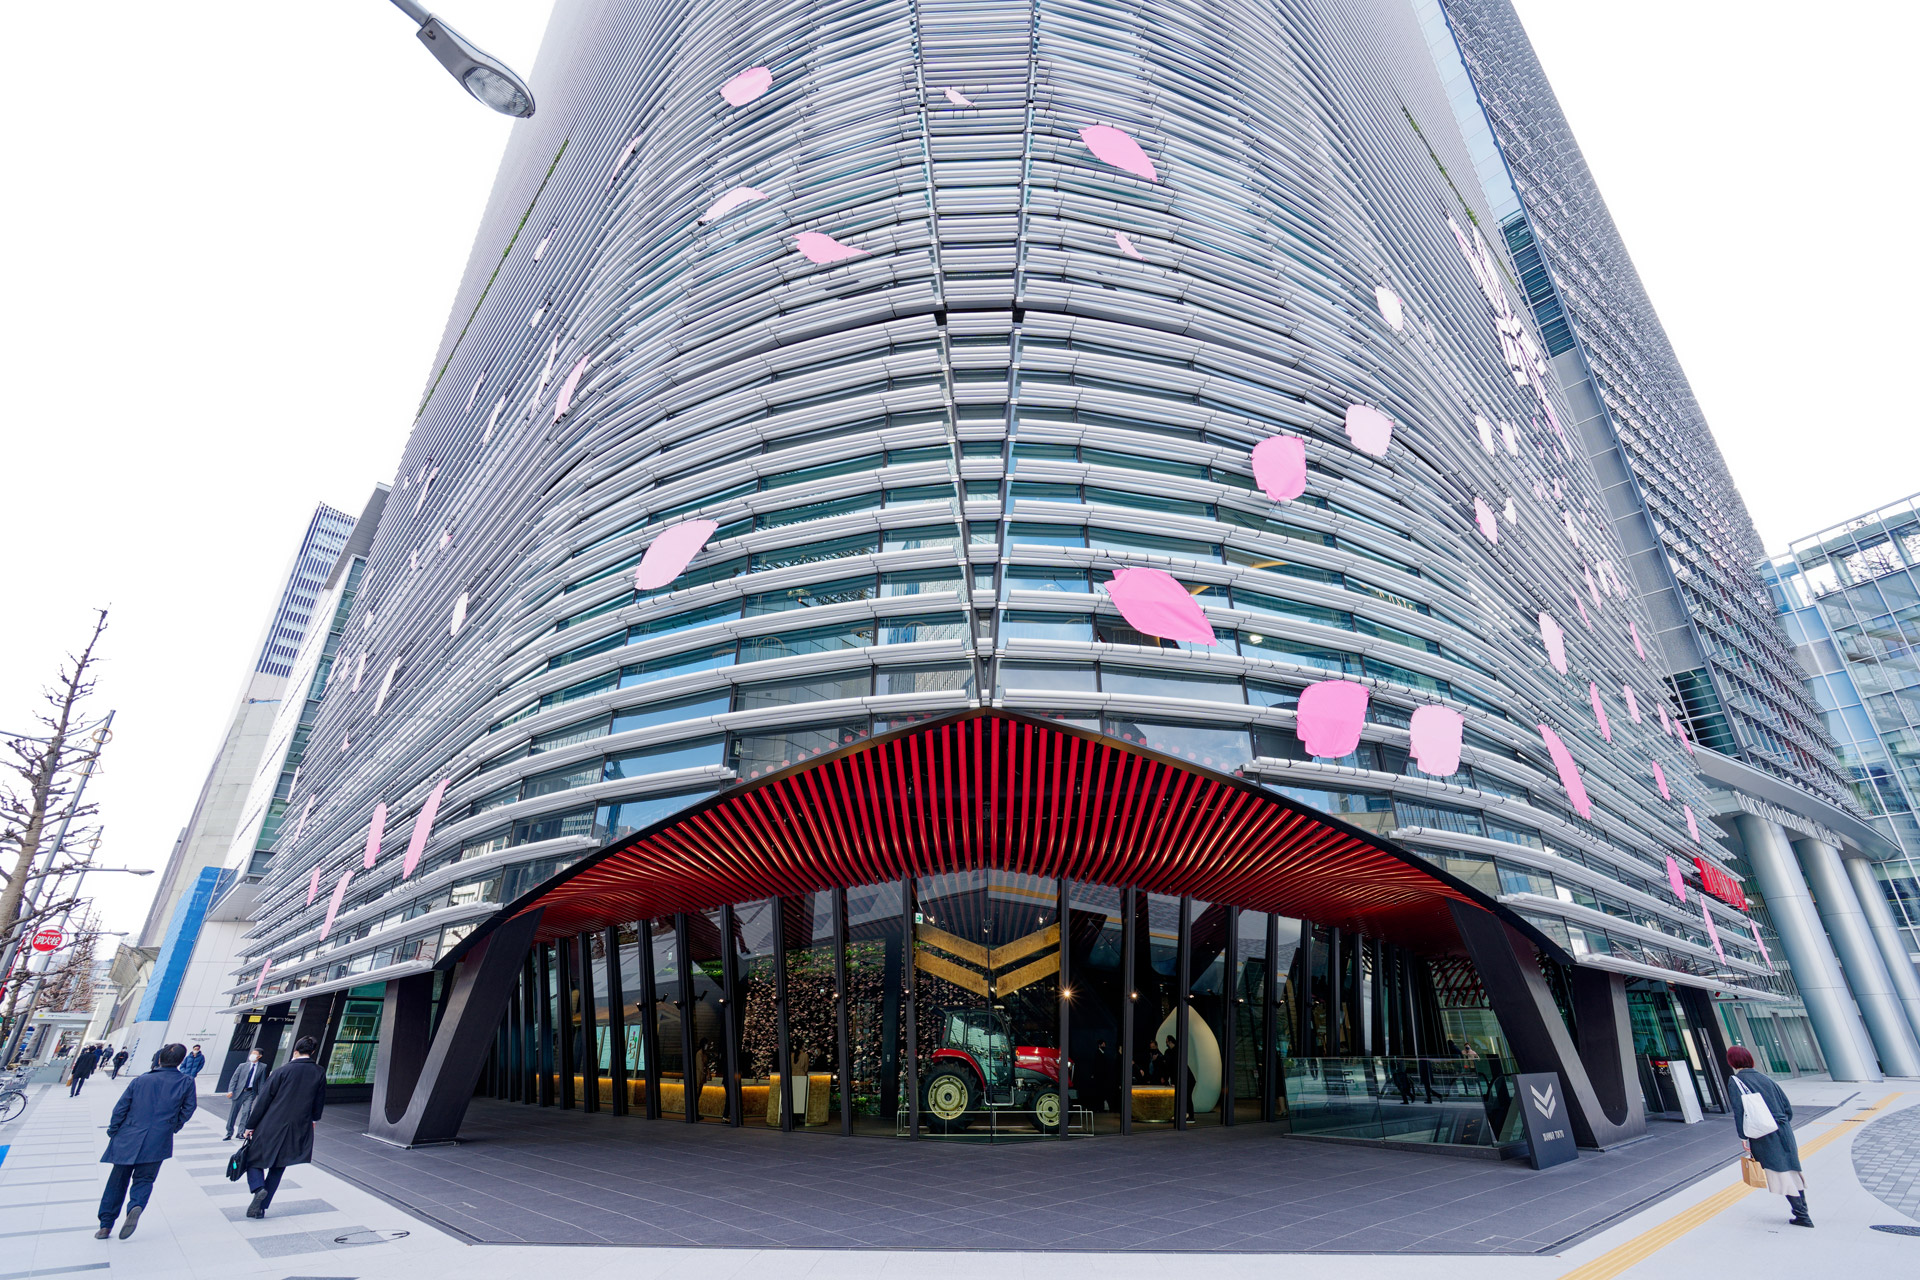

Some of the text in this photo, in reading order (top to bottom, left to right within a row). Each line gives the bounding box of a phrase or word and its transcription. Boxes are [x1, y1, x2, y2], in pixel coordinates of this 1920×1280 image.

[1733, 790, 1774, 822] TOKYO
[34, 935, 61, 946] 消火栓
